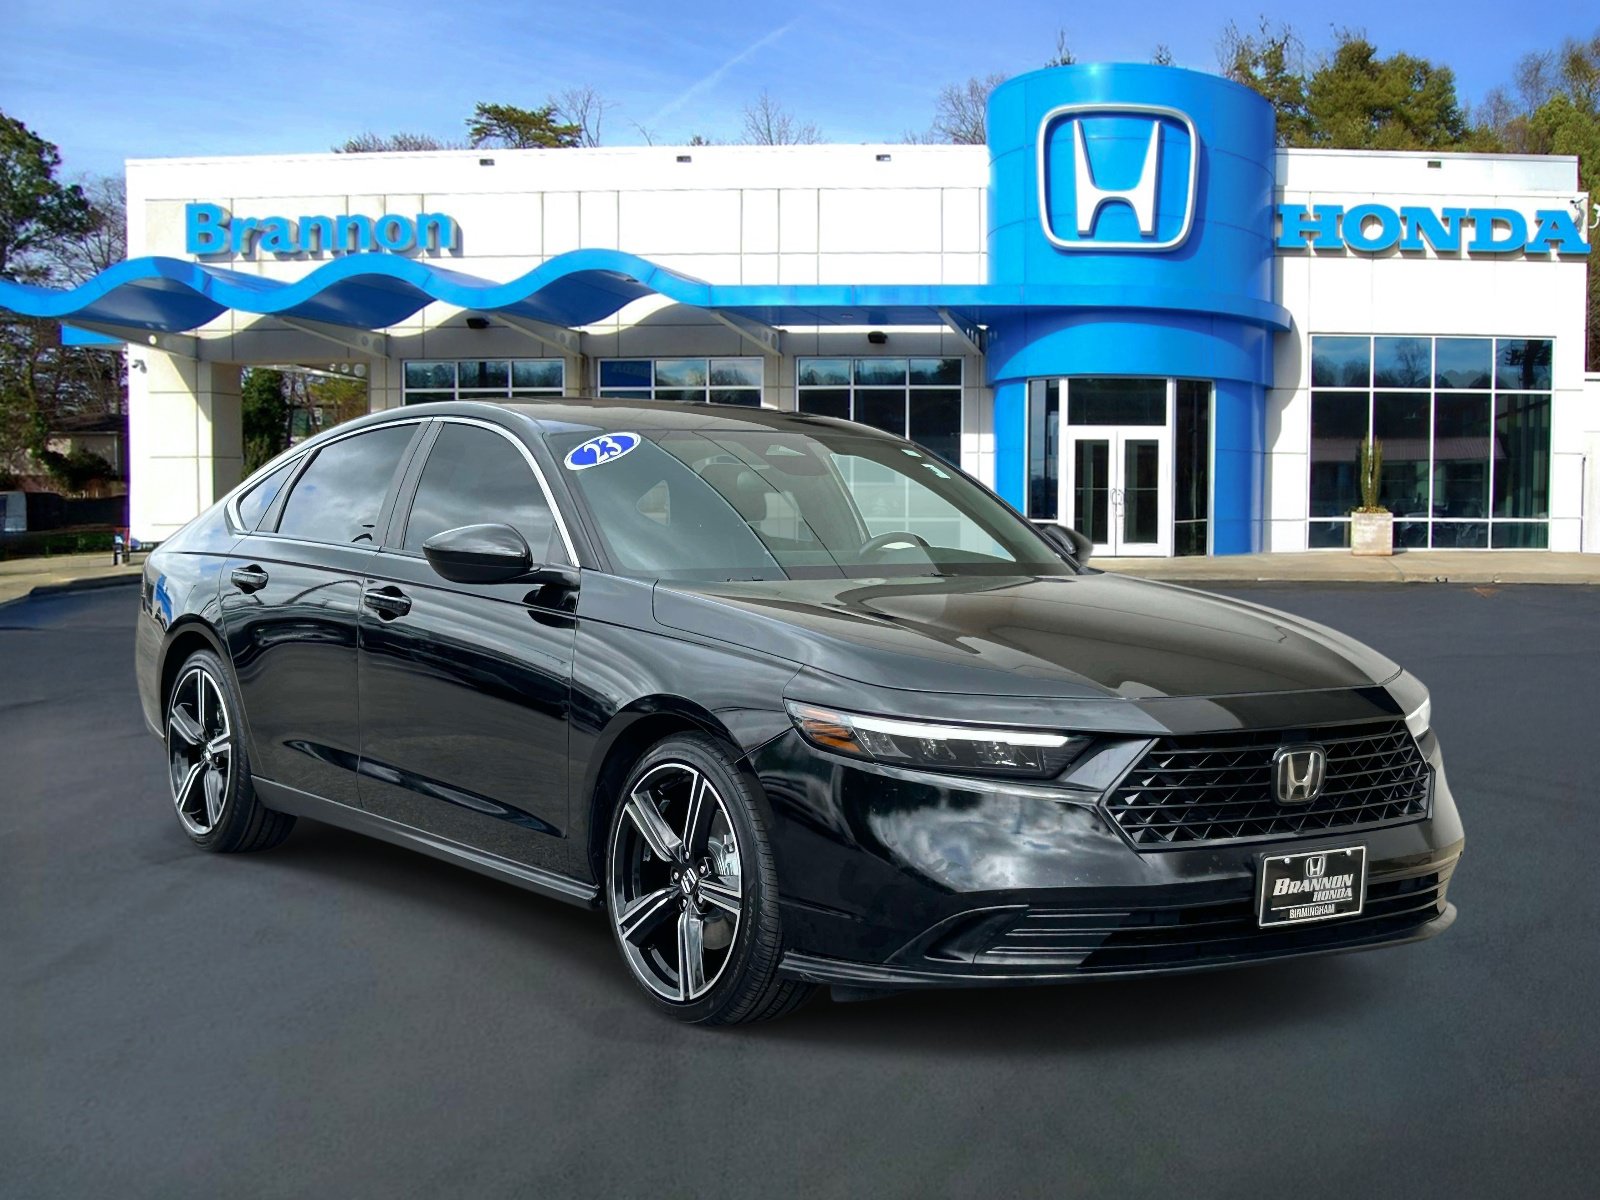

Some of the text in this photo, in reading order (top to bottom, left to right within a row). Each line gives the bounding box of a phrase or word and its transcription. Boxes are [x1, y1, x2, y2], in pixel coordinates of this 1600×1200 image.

[186, 203, 455, 252] Brannon
[1277, 204, 1592, 254] HONDA
[583, 437, 622, 464] 23
[1273, 874, 1353, 896] BRANNON
[1312, 887, 1352, 902] HONDA
[1289, 904, 1335, 919] BIRMINGHAM
